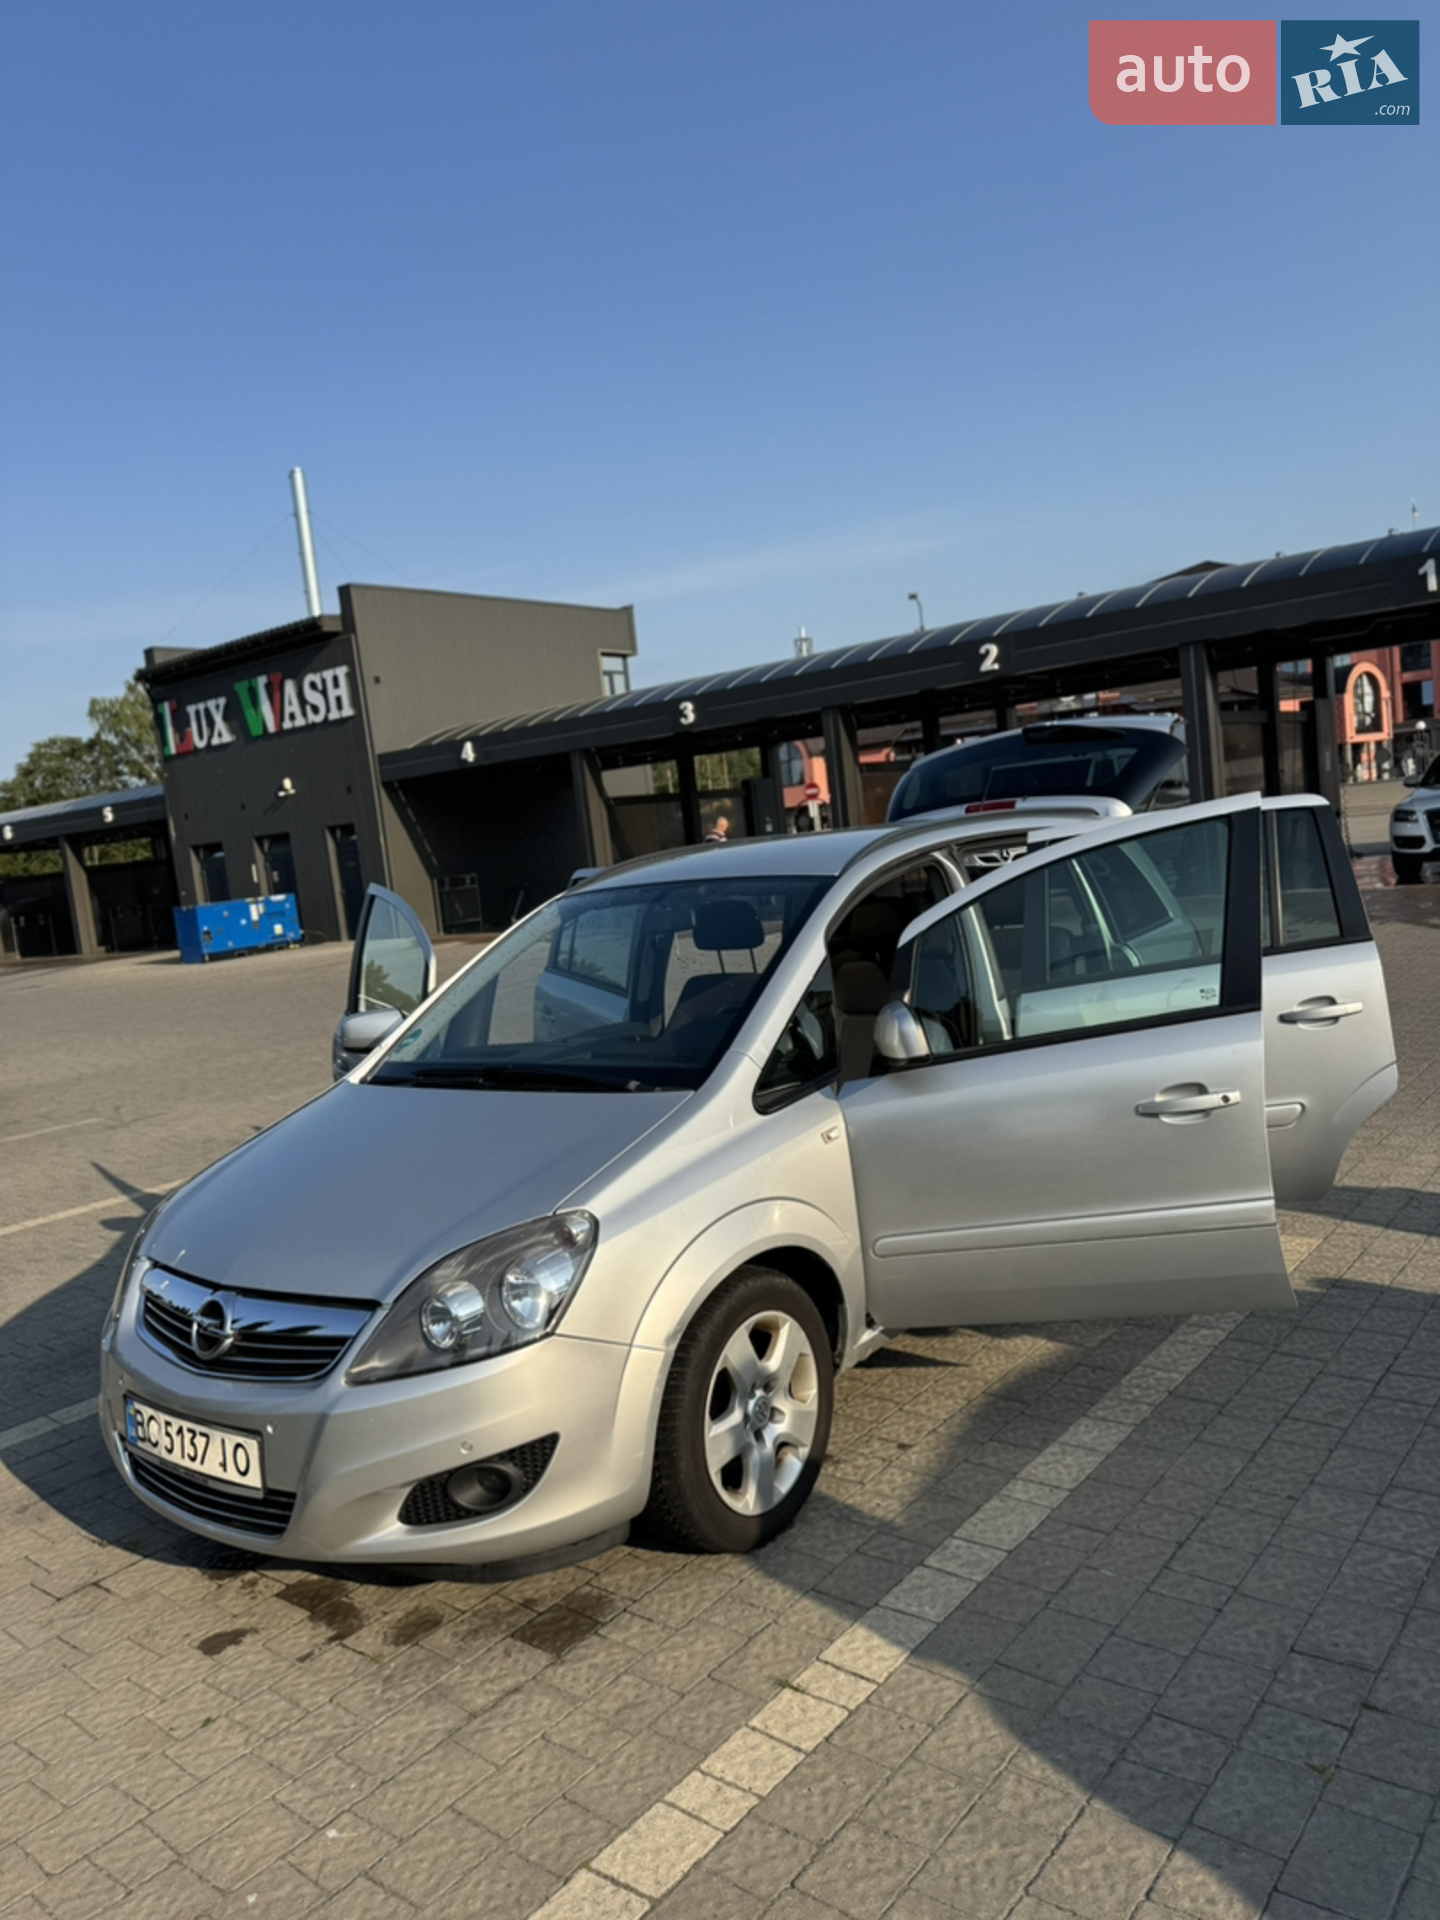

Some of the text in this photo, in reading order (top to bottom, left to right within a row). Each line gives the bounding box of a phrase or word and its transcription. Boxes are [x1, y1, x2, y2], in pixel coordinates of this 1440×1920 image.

[1418, 558, 1437, 592] 1
[979, 642, 999, 672] 2
[157, 664, 355, 758] LUX WASH
[679, 701, 696, 725] 3
[461, 740, 475, 763] 4
[102, 806, 114, 823] 5
